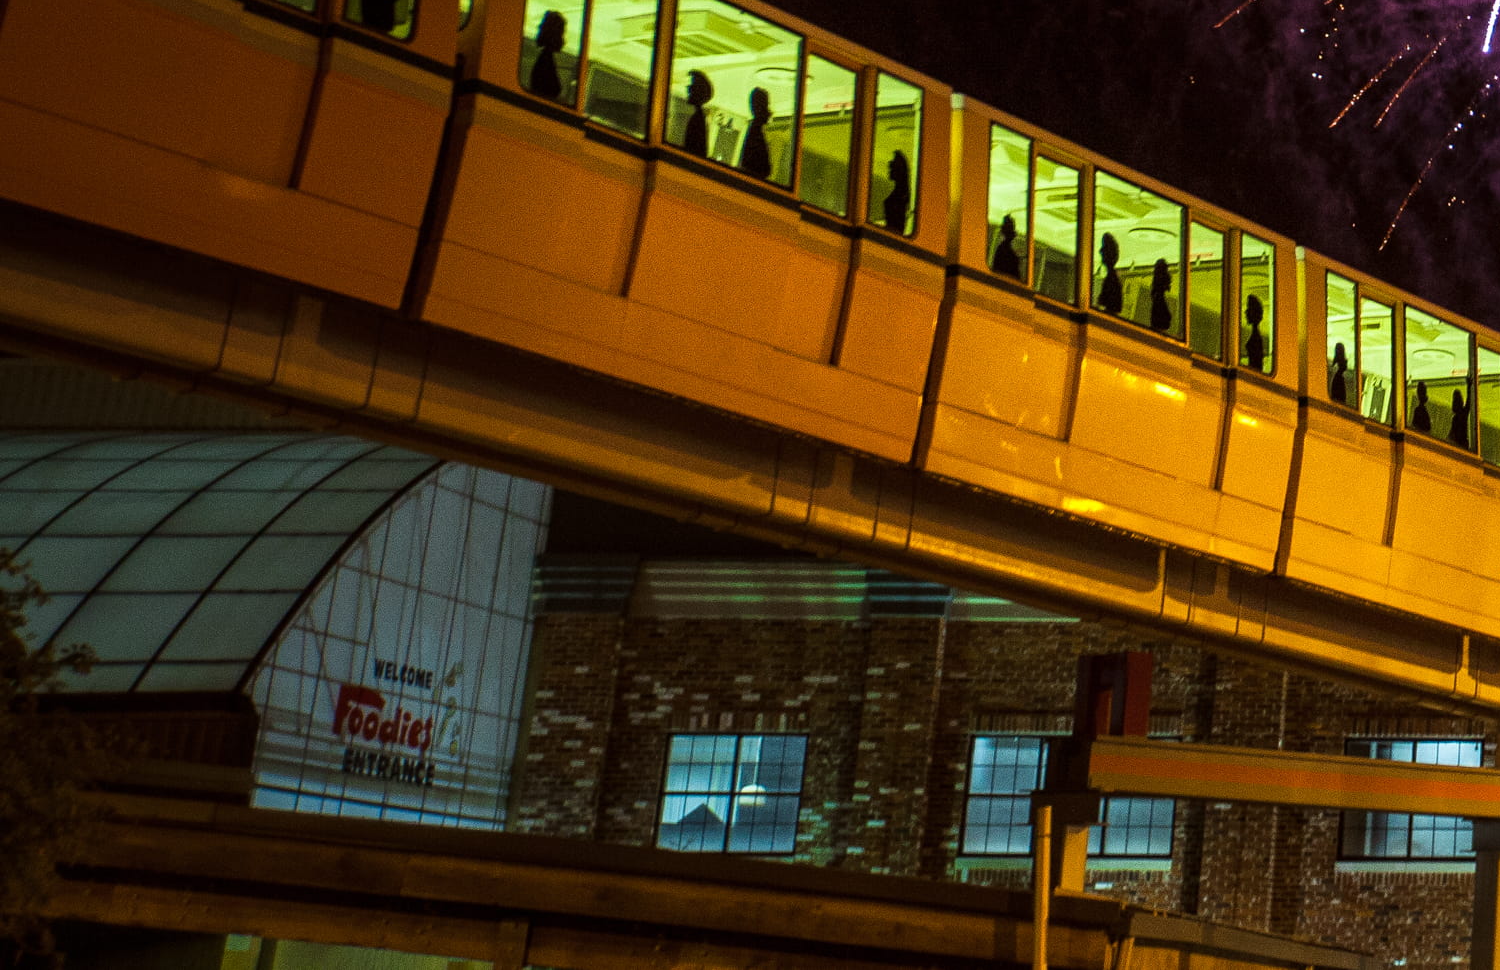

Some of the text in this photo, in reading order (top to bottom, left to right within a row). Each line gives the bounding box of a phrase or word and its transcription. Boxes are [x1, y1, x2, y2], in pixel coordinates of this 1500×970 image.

[374, 659, 433, 689] WELCOME
[334, 683, 433, 751] Foodies
[343, 750, 435, 786] ENTRANCE
